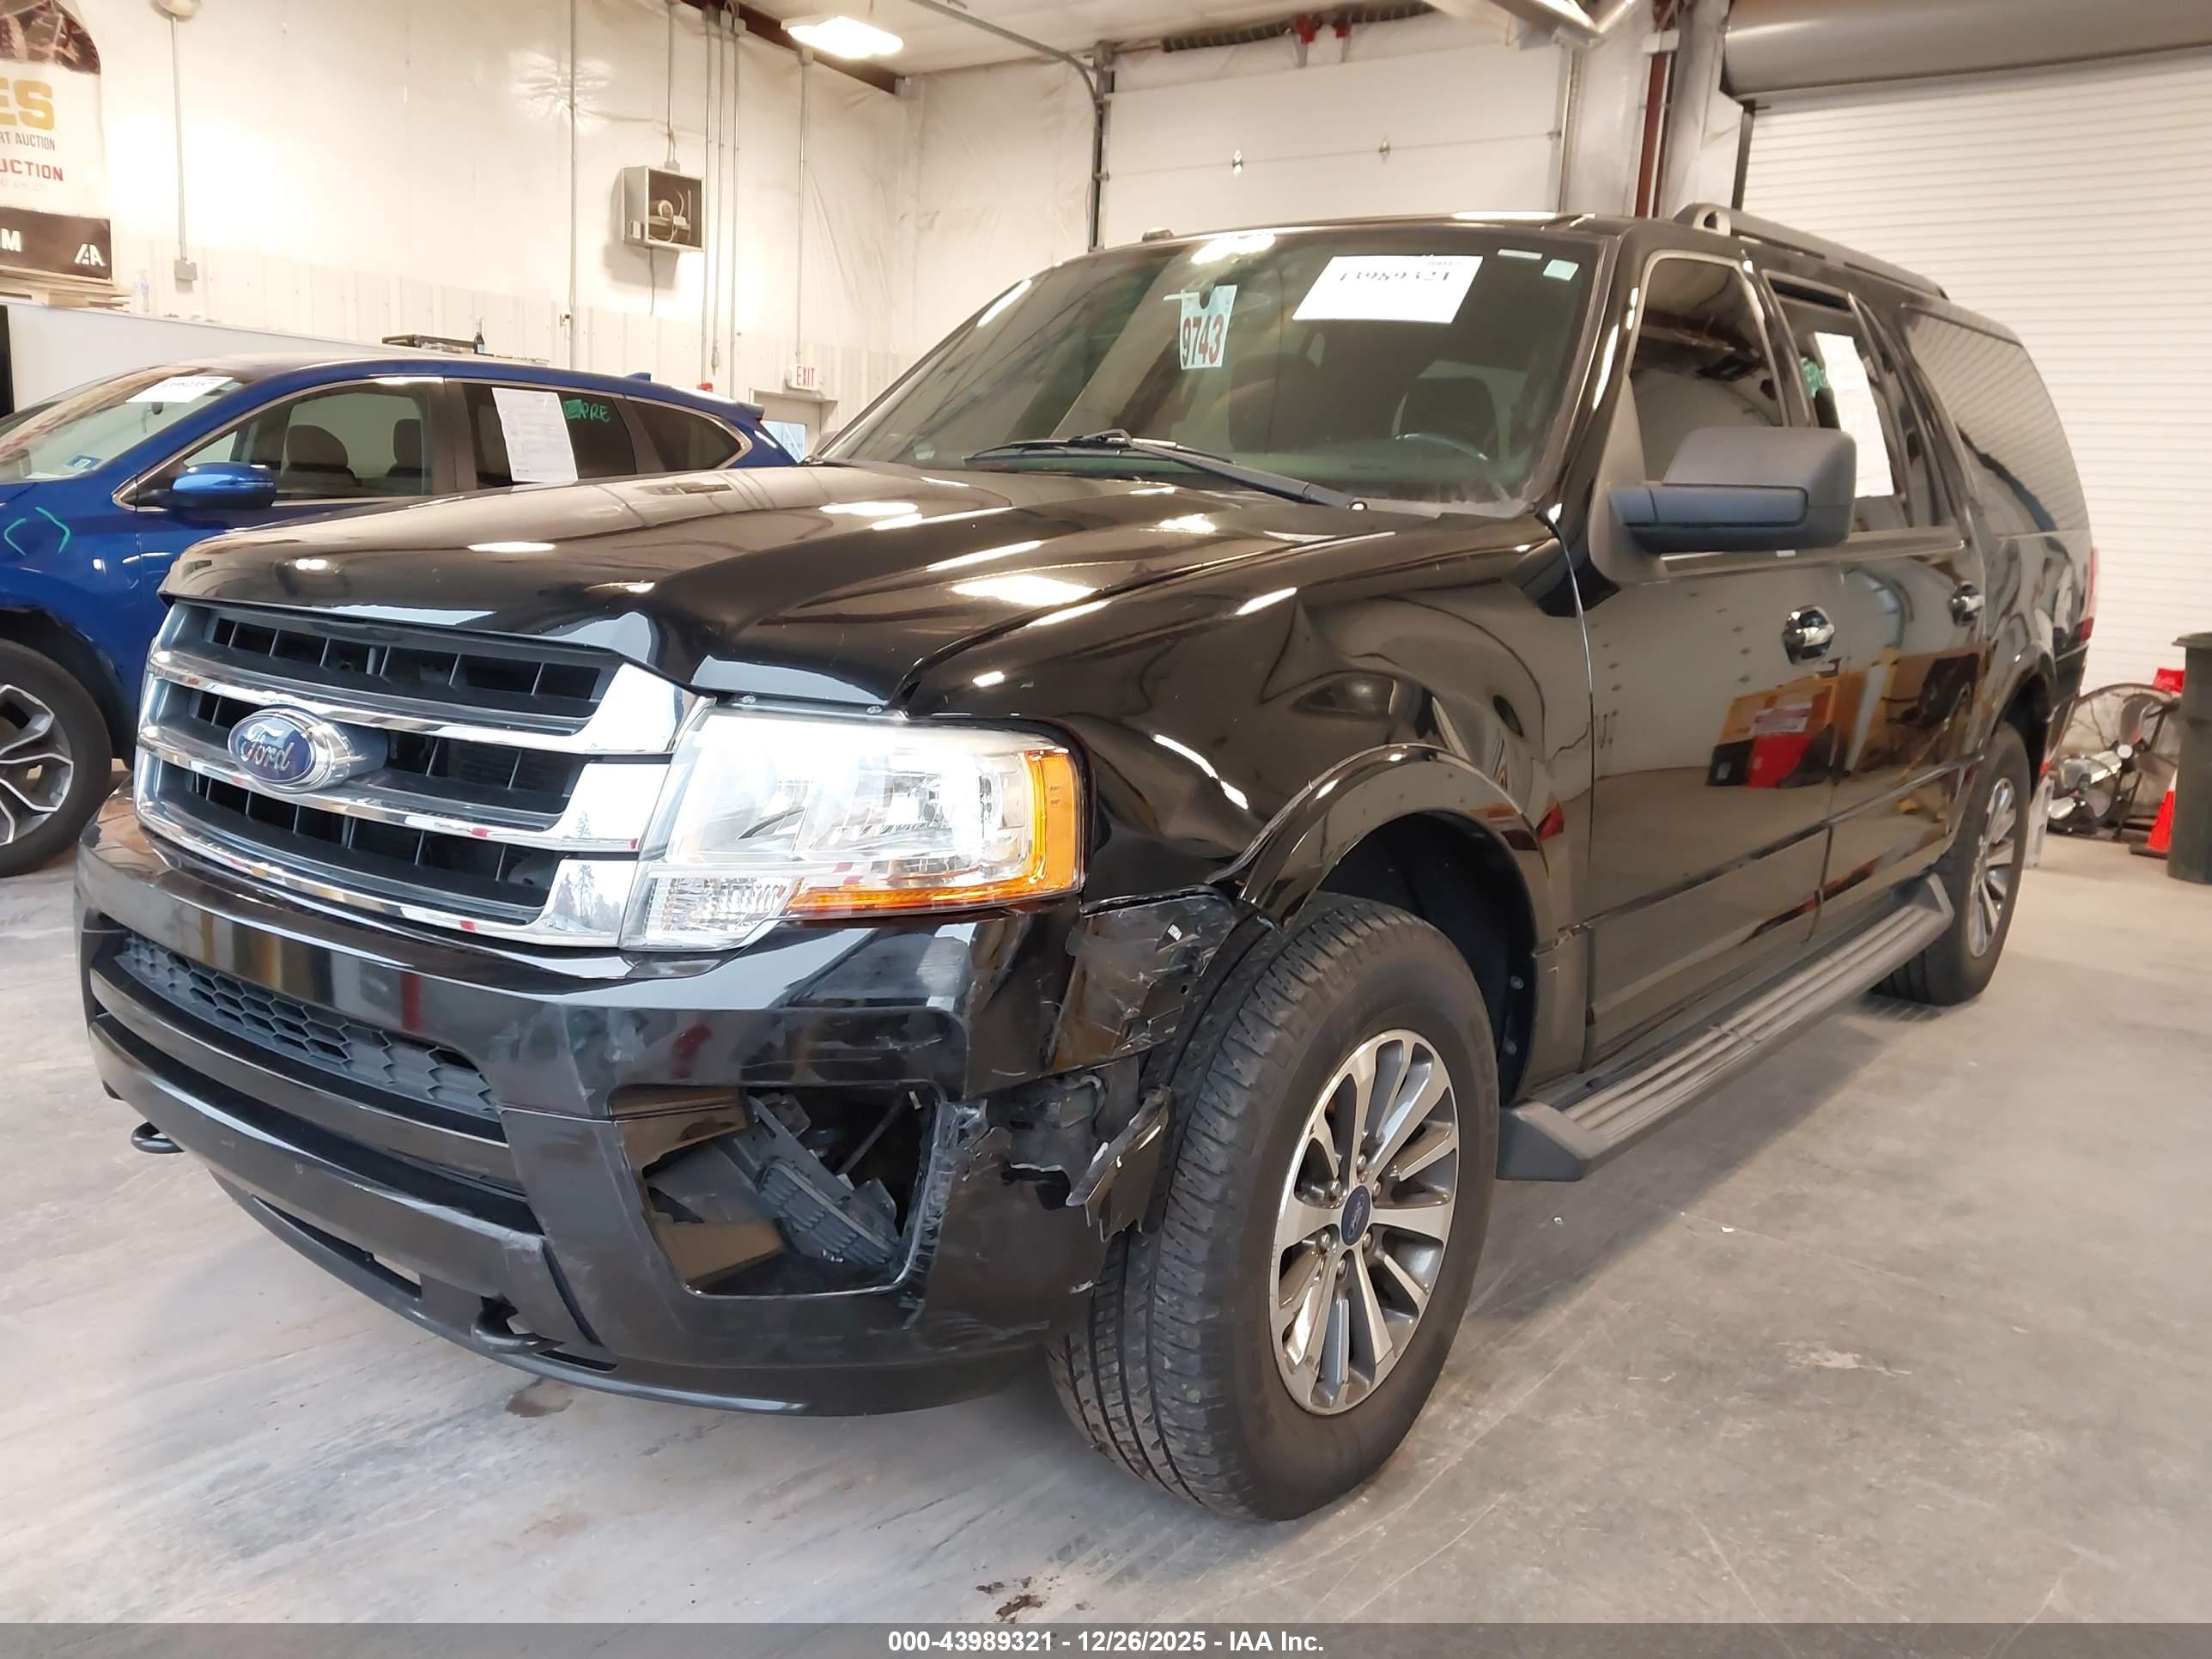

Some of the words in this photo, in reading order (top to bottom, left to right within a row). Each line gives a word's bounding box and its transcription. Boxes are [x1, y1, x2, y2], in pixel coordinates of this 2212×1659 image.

[15, 132, 55, 151] AUCTION
[1182, 314, 1224, 367] 9743
[796, 366, 815, 387] EXIT
[240, 722, 295, 771] Ford
